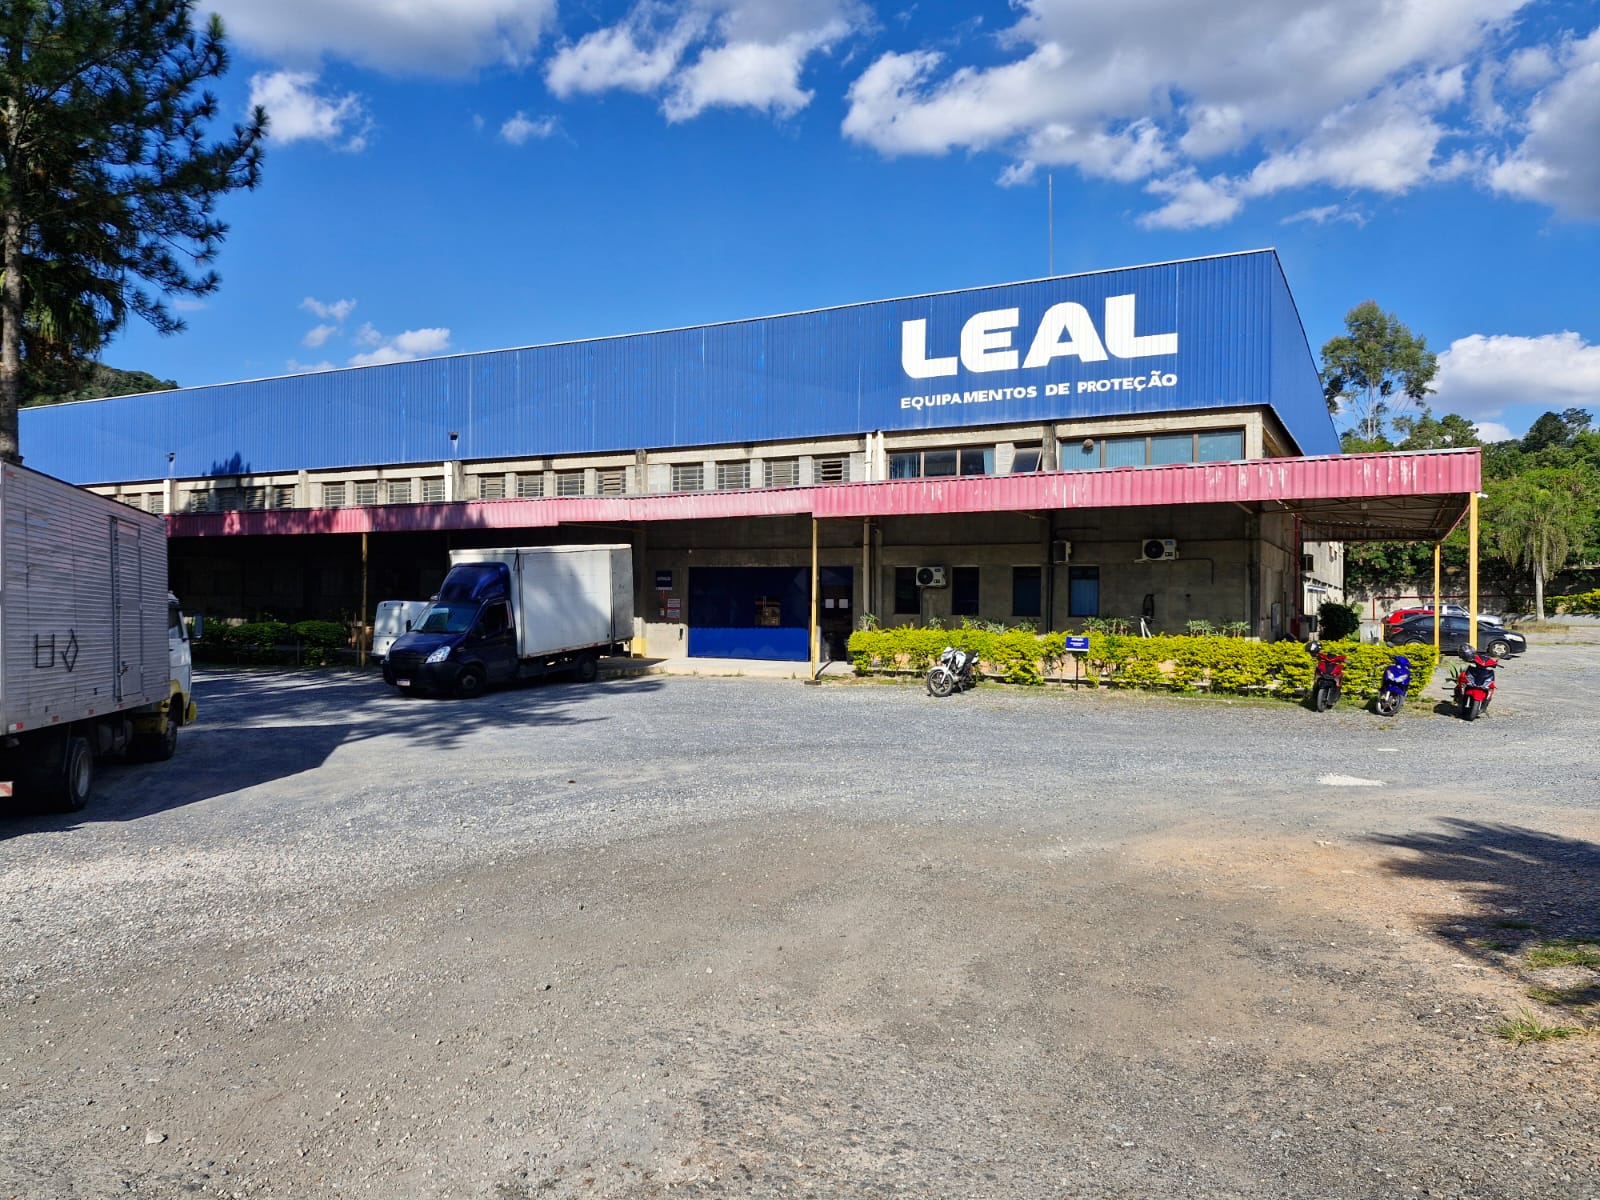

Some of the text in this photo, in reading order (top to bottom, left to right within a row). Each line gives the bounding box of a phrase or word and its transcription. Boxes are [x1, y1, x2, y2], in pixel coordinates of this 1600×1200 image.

[901, 294, 1178, 379] LEAL
[900, 370, 1178, 410] EQUIPAMENTOS DE PROTEÇÃO
